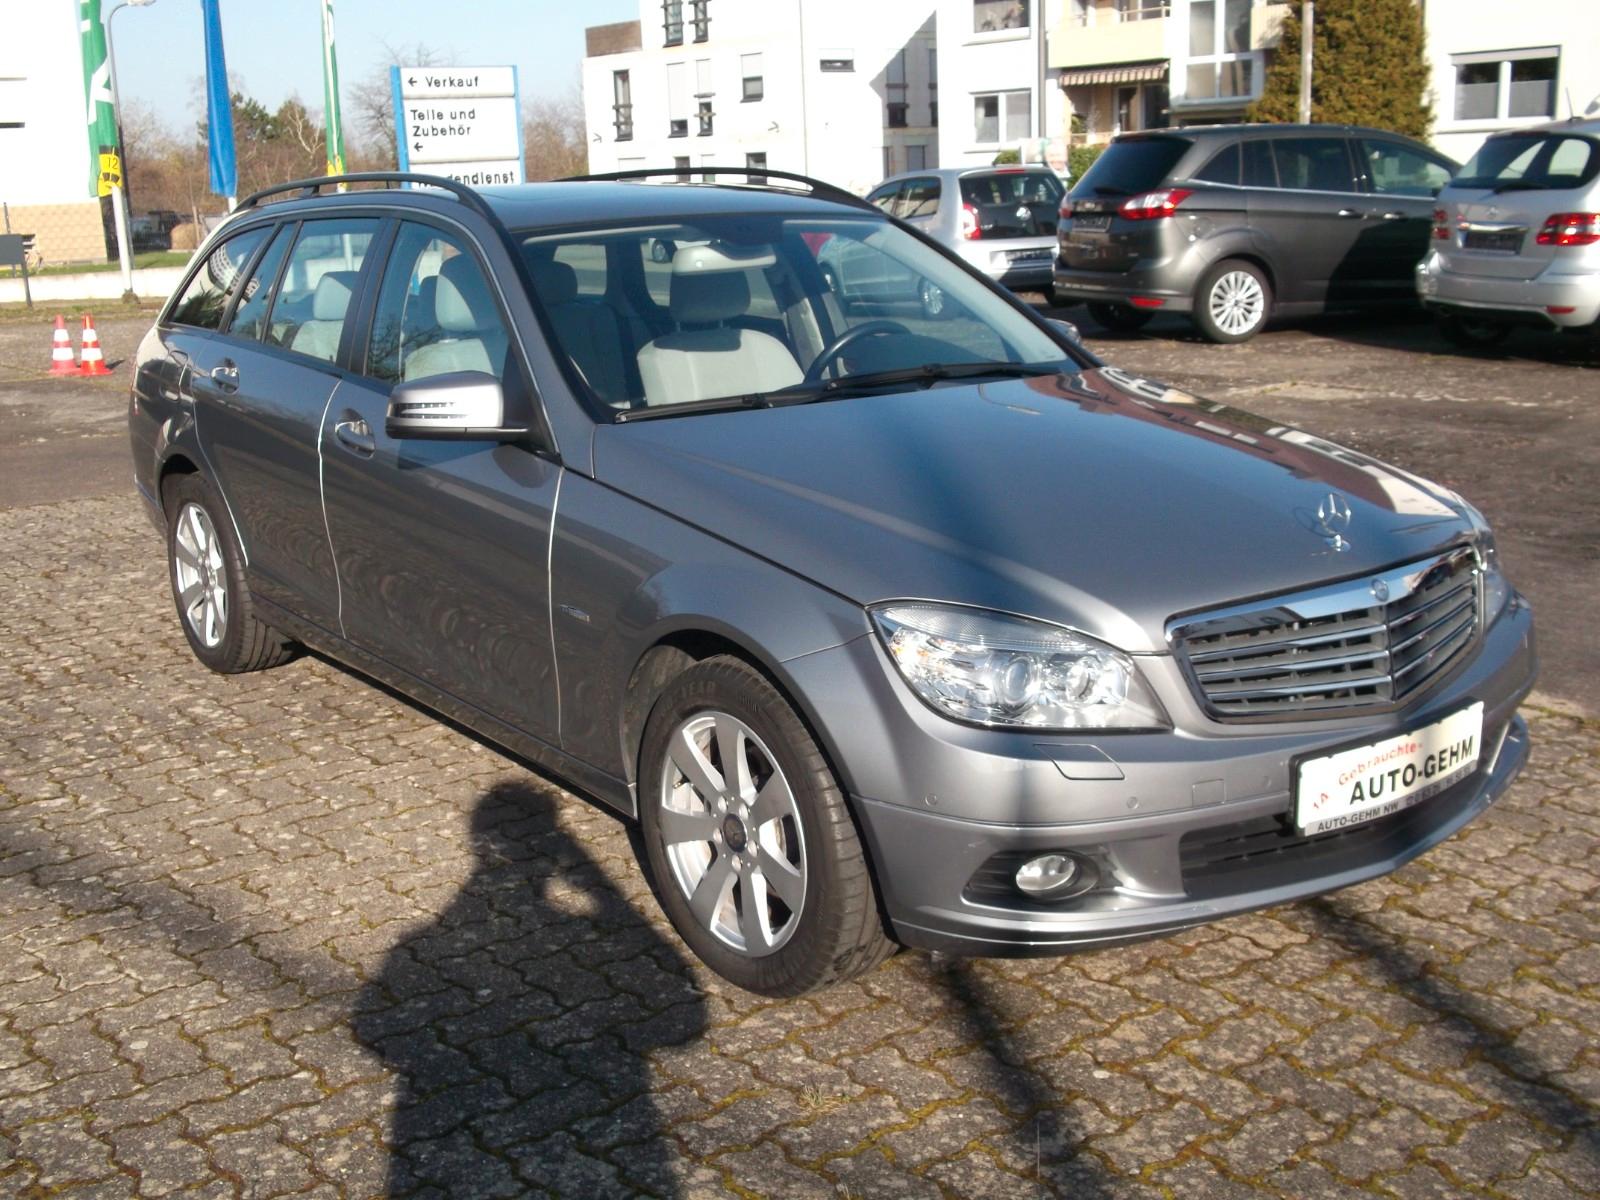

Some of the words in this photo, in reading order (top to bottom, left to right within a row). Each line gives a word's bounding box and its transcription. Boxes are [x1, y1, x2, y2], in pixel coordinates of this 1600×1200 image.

[425, 76, 479, 88] Verkauf
[410, 109, 444, 121] Teile
[450, 108, 476, 120] und
[412, 125, 471, 137] Zubehör
[1349, 735, 1474, 805] AUTO-GEHM
[1318, 807, 1381, 832] AUTO-GEHM
[1383, 801, 1400, 815] NW
